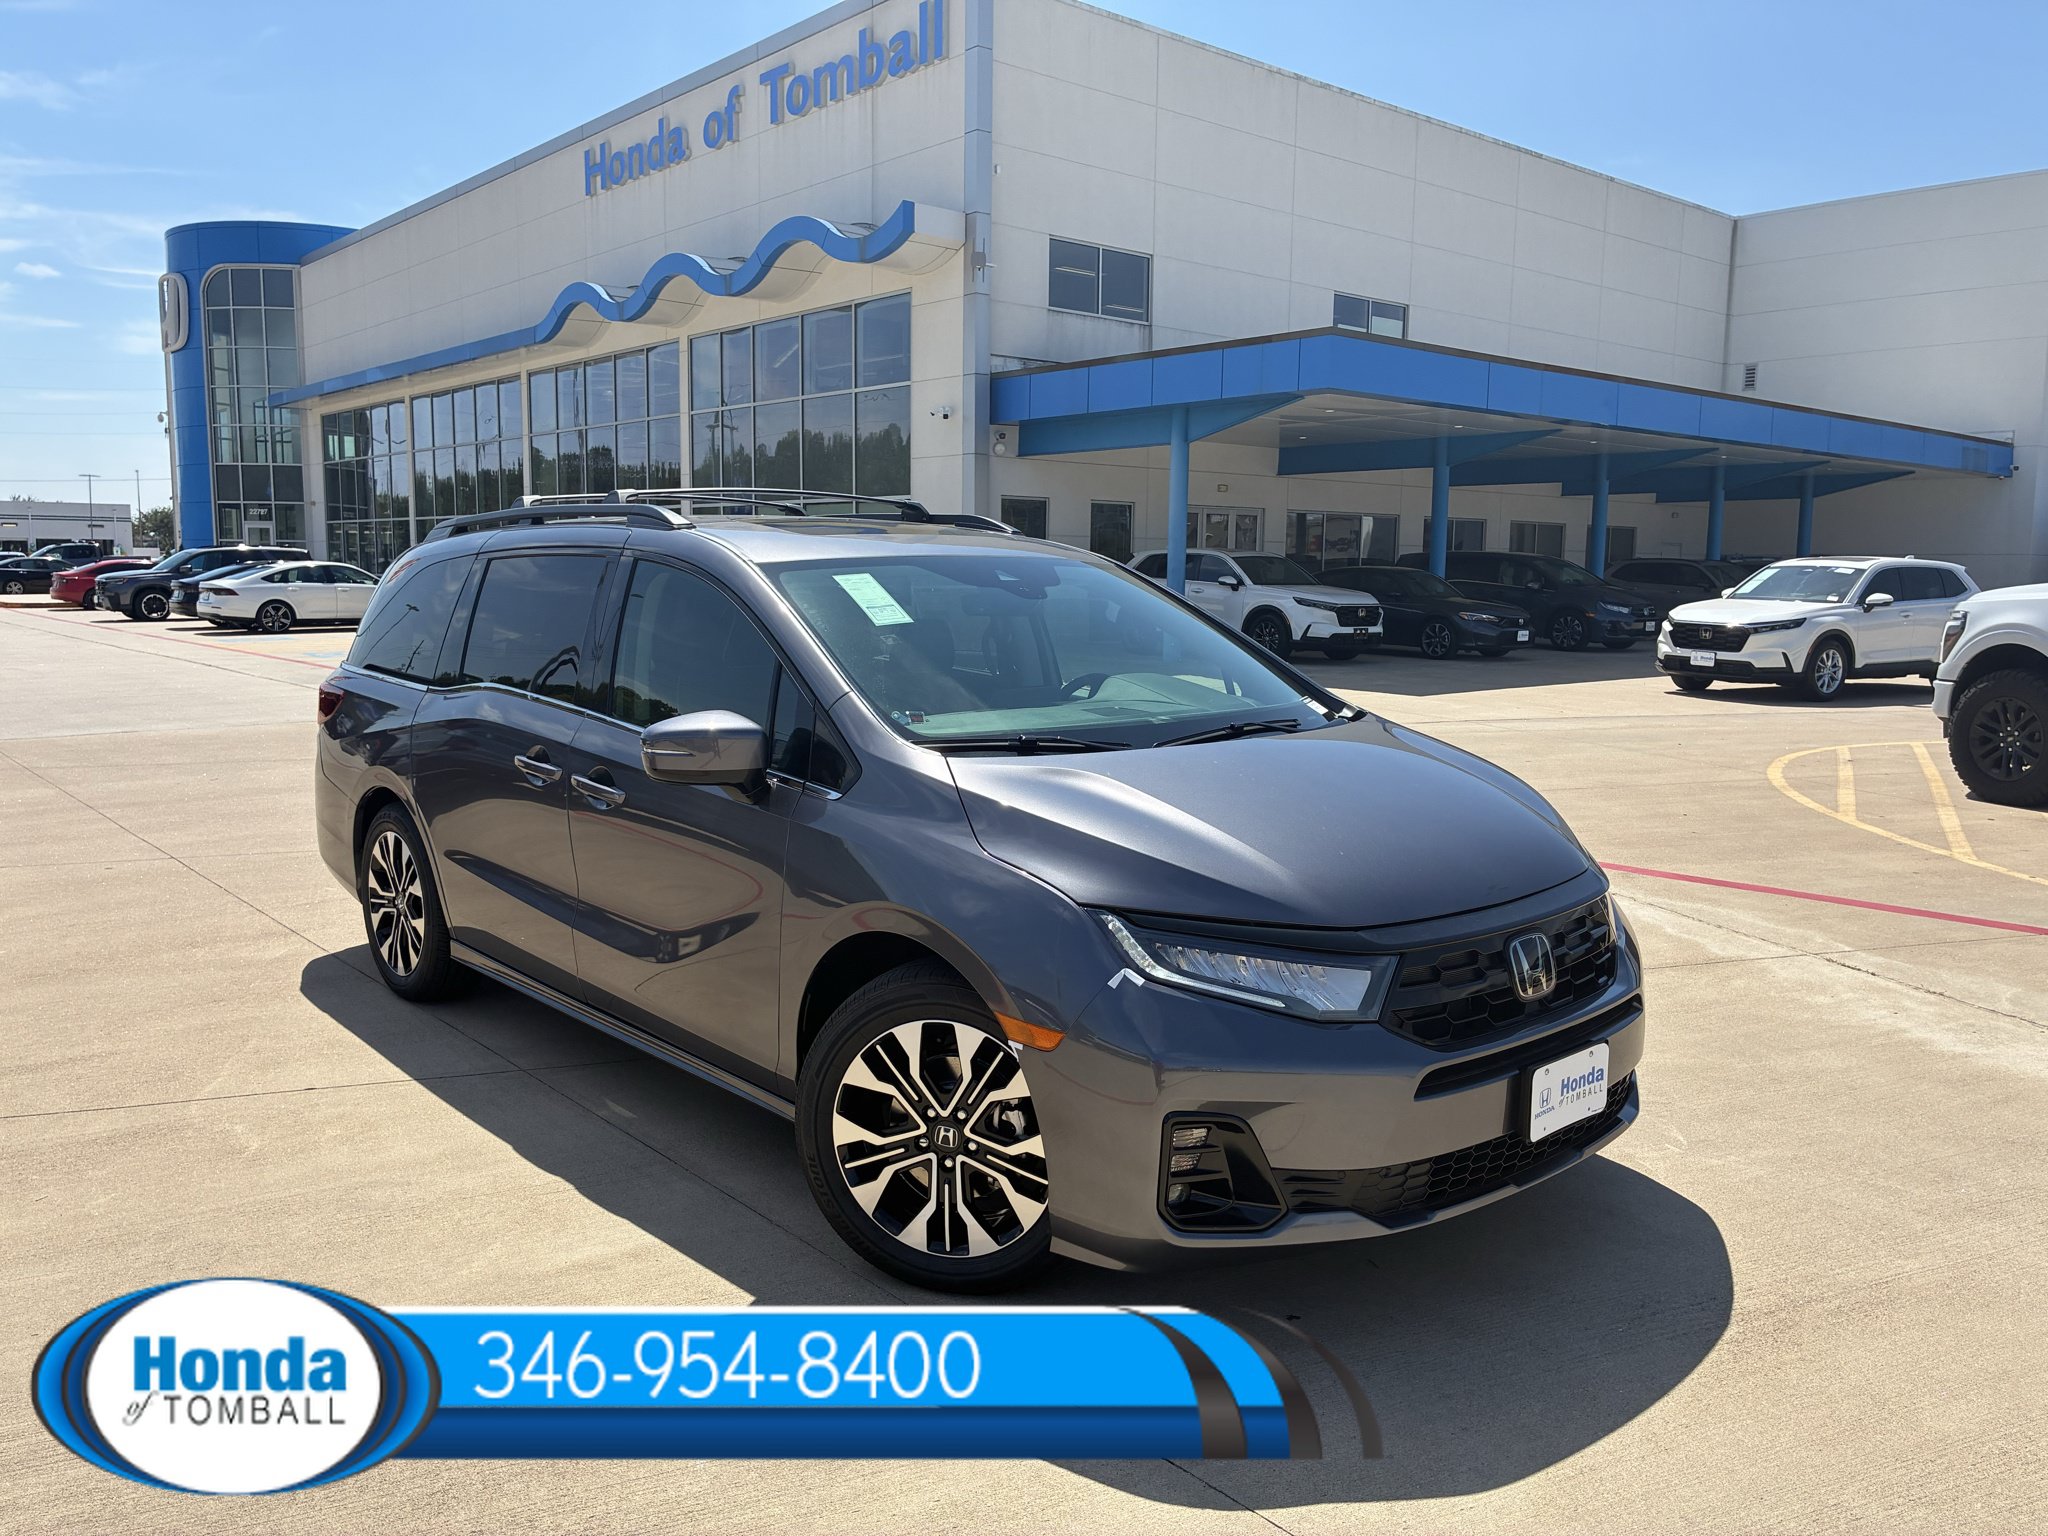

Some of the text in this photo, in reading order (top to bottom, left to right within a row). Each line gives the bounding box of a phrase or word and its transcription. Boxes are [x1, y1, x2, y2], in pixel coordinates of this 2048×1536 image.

[584, 0, 946, 196] Honda of Tomball
[1560, 1066, 1604, 1097] Honda
[1565, 1083, 1603, 1106] TOMBALL
[1534, 1105, 1555, 1120] HONDA
